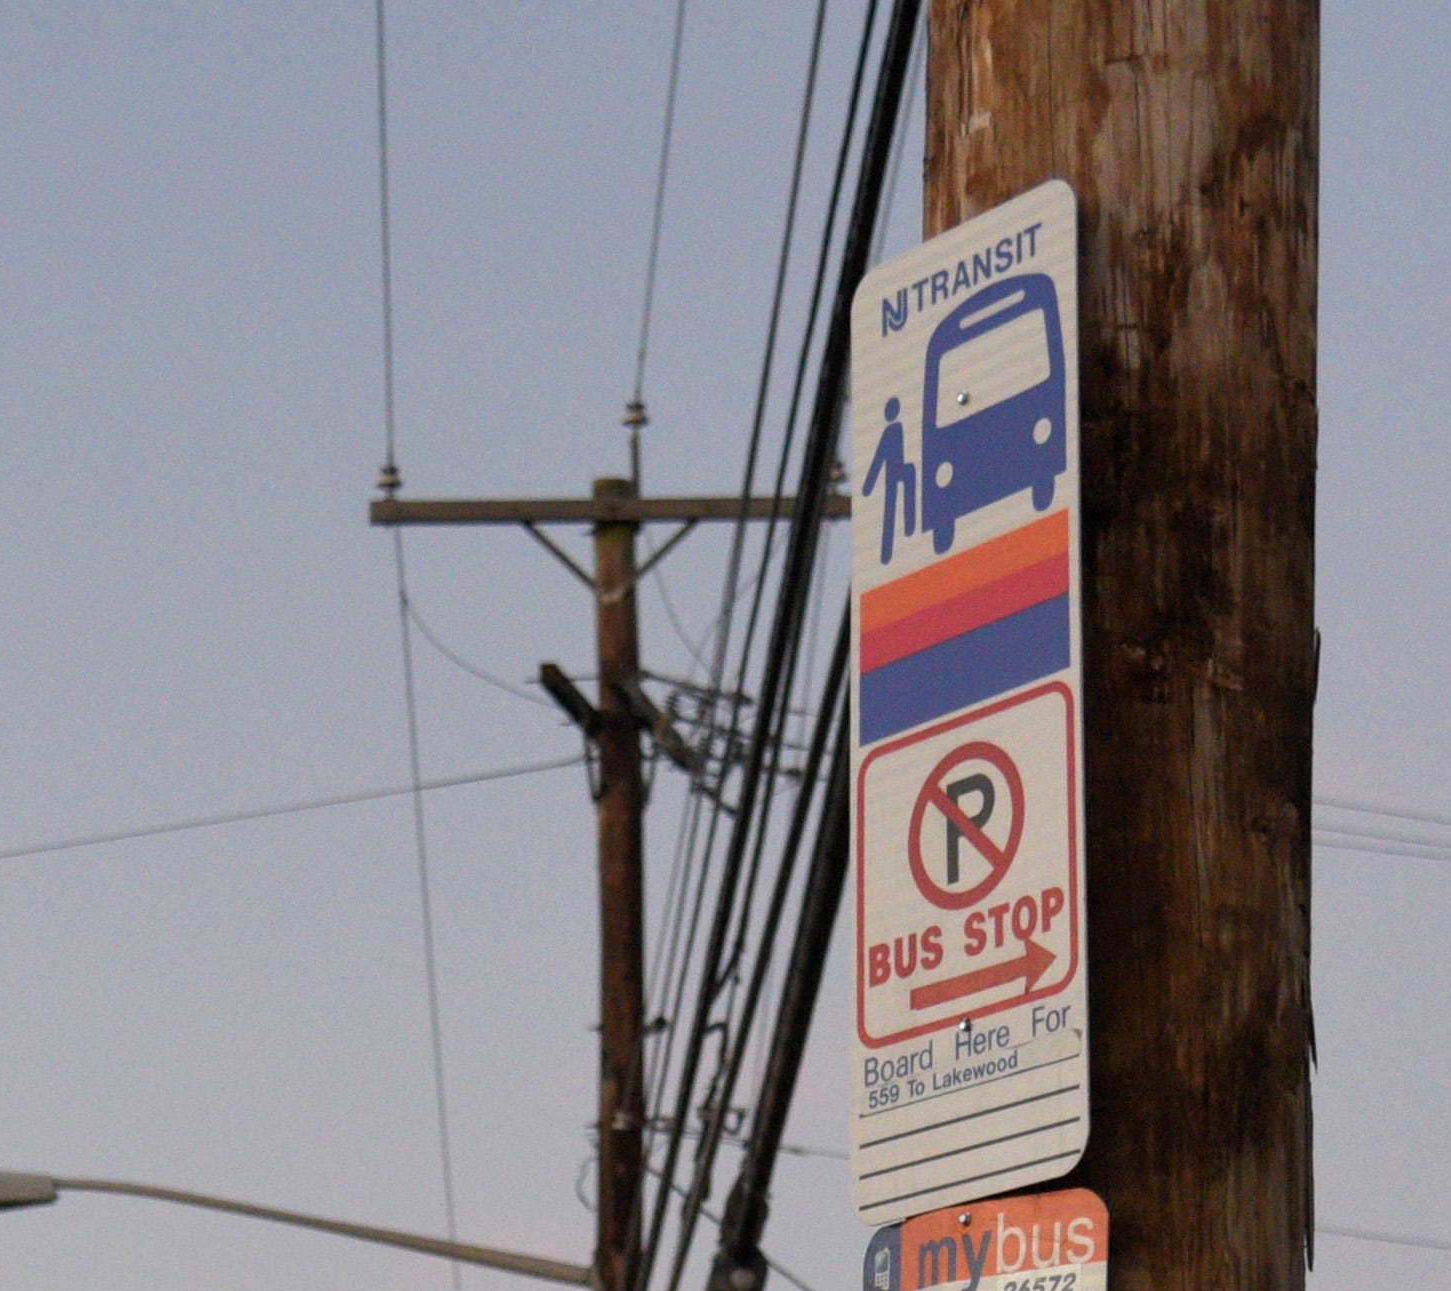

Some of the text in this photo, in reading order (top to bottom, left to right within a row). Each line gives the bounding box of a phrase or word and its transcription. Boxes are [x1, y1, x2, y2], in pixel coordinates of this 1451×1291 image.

[946, 772, 996, 886] P
[868, 886, 1065, 988] BUS STOP
[863, 1003, 1072, 1088] Board Here For
[868, 1049, 1019, 1110] 559 To Lakewood
